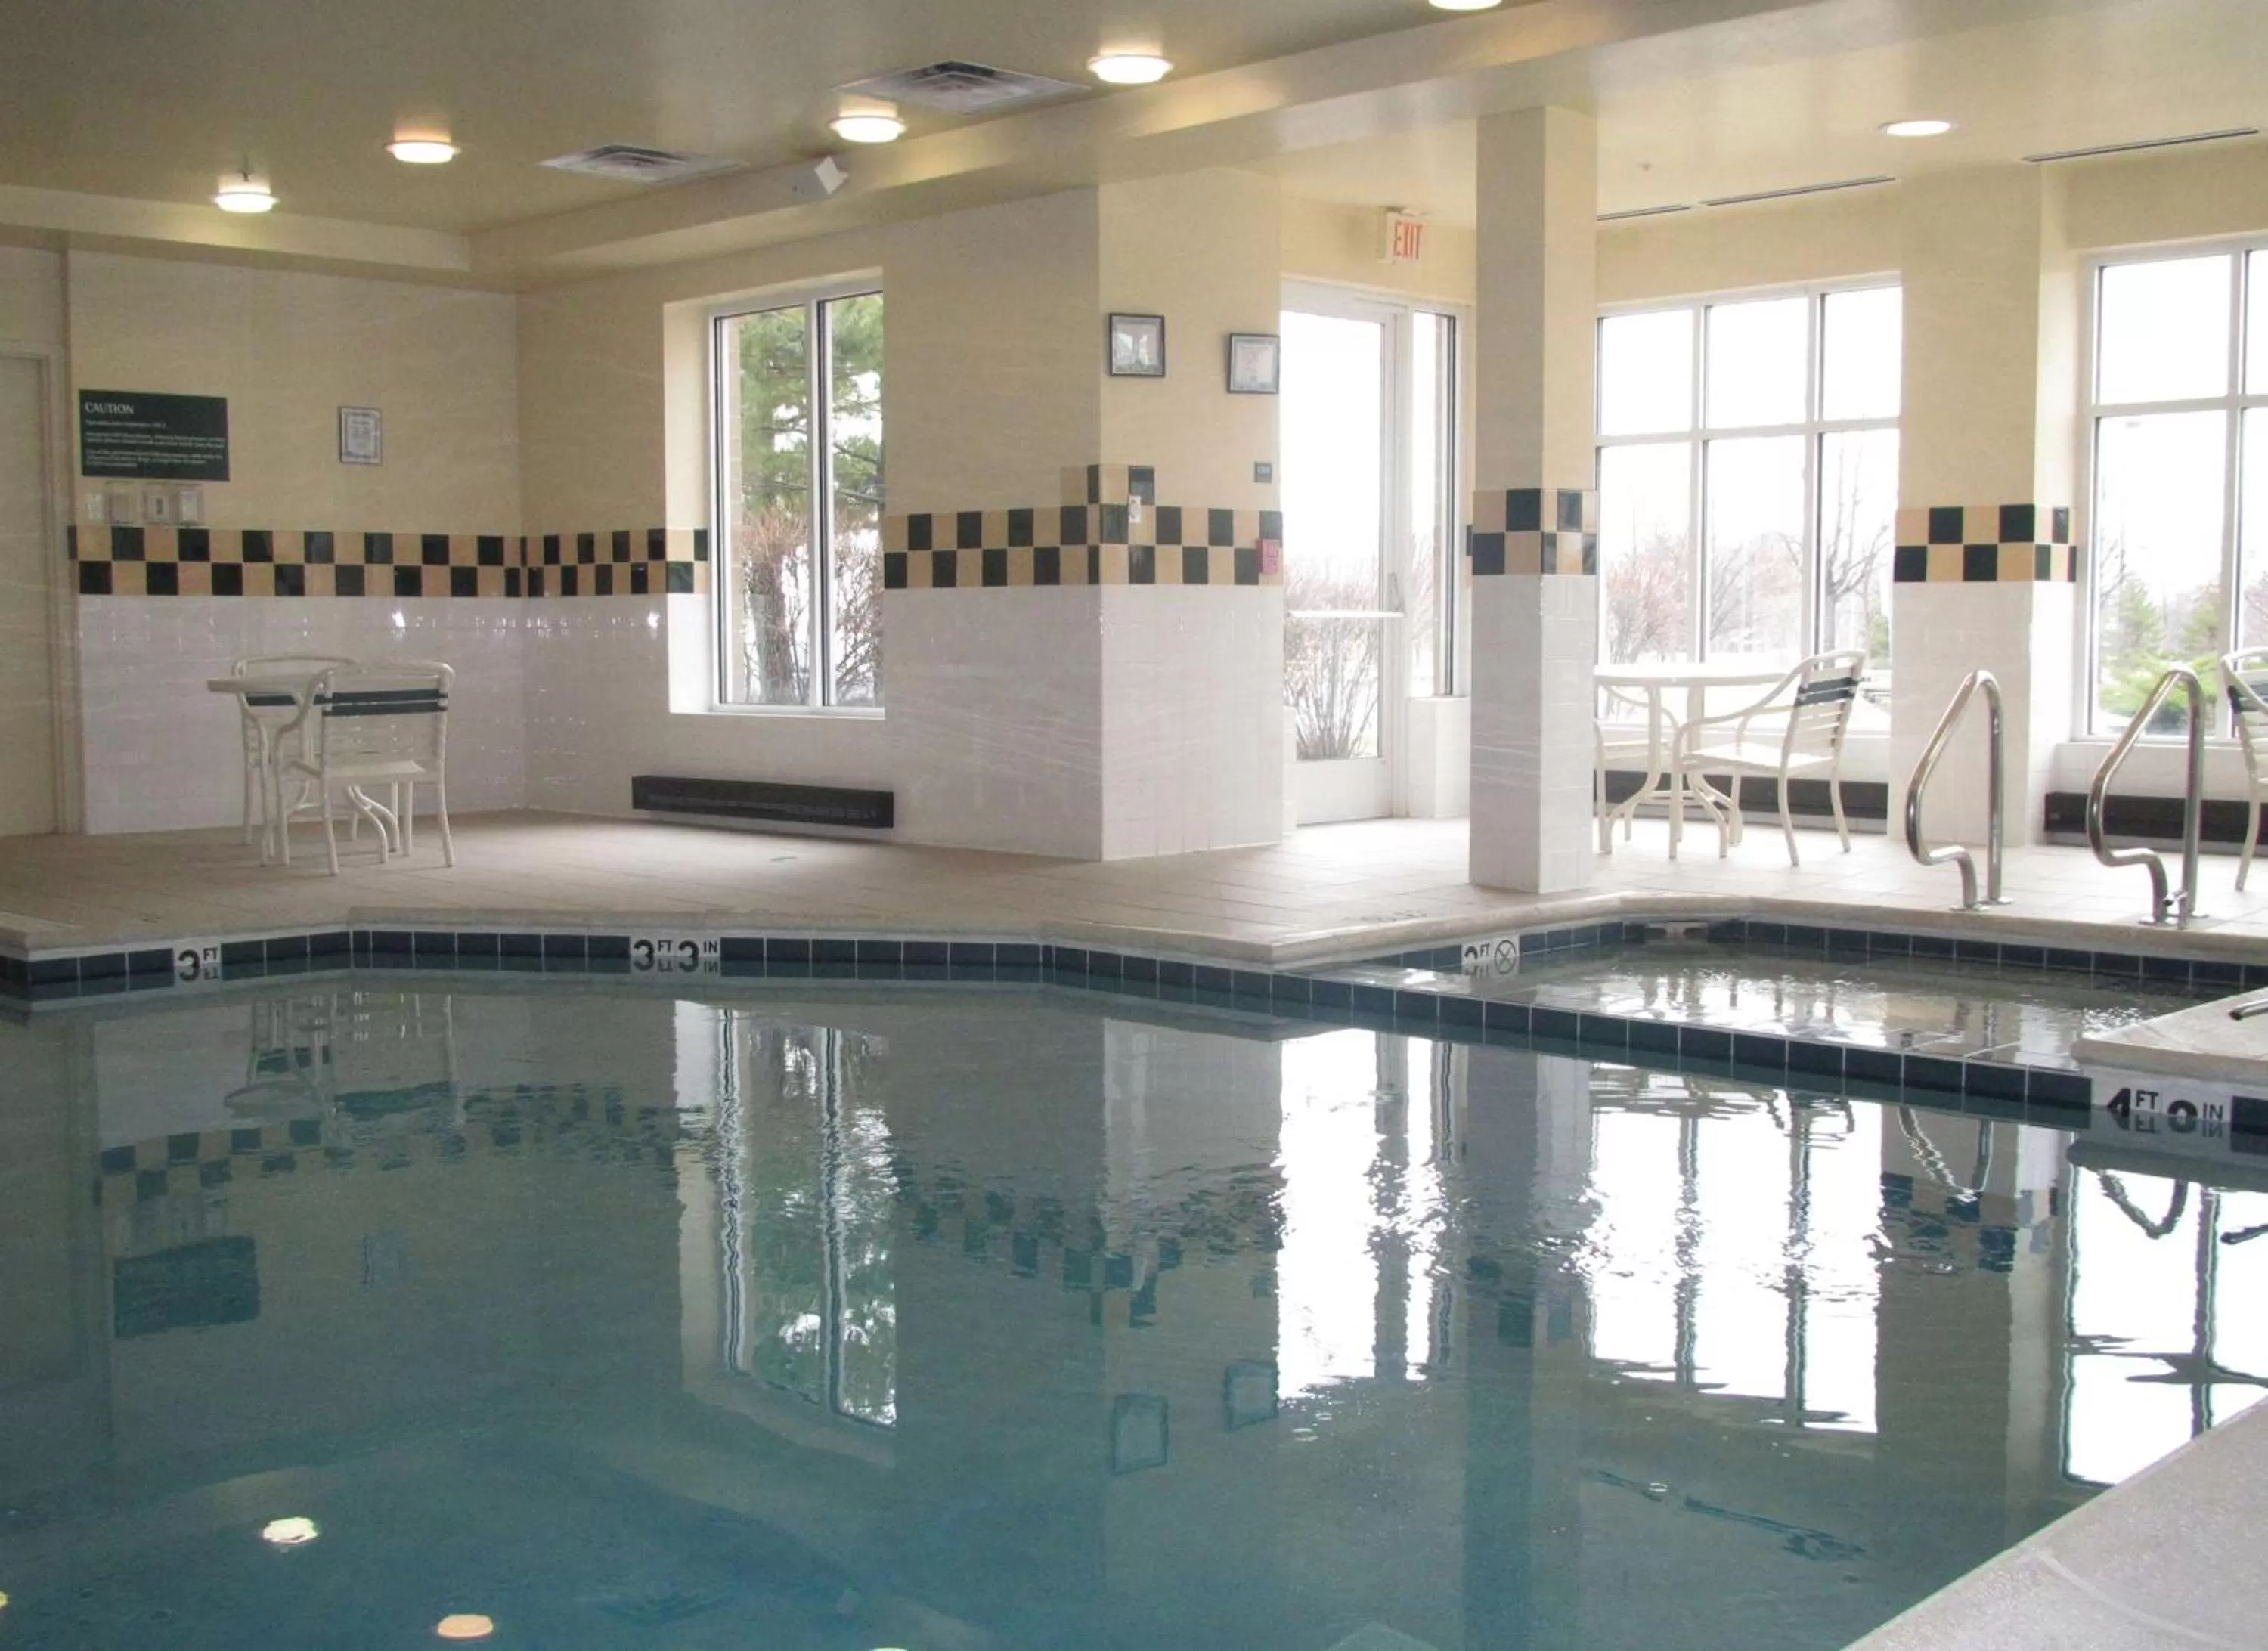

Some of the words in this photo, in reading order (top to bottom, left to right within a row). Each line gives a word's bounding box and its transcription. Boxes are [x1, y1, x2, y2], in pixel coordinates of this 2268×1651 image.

[1393, 220, 1424, 261] EXIT
[84, 401, 135, 415] CAUTION
[657, 940, 674, 952] FT
[703, 940, 718, 954] IN
[1479, 943, 1489, 957] FT
[203, 947, 218, 962] FT
[2136, 1089, 2159, 1110] FT
[2203, 1102, 2223, 1120] IN
